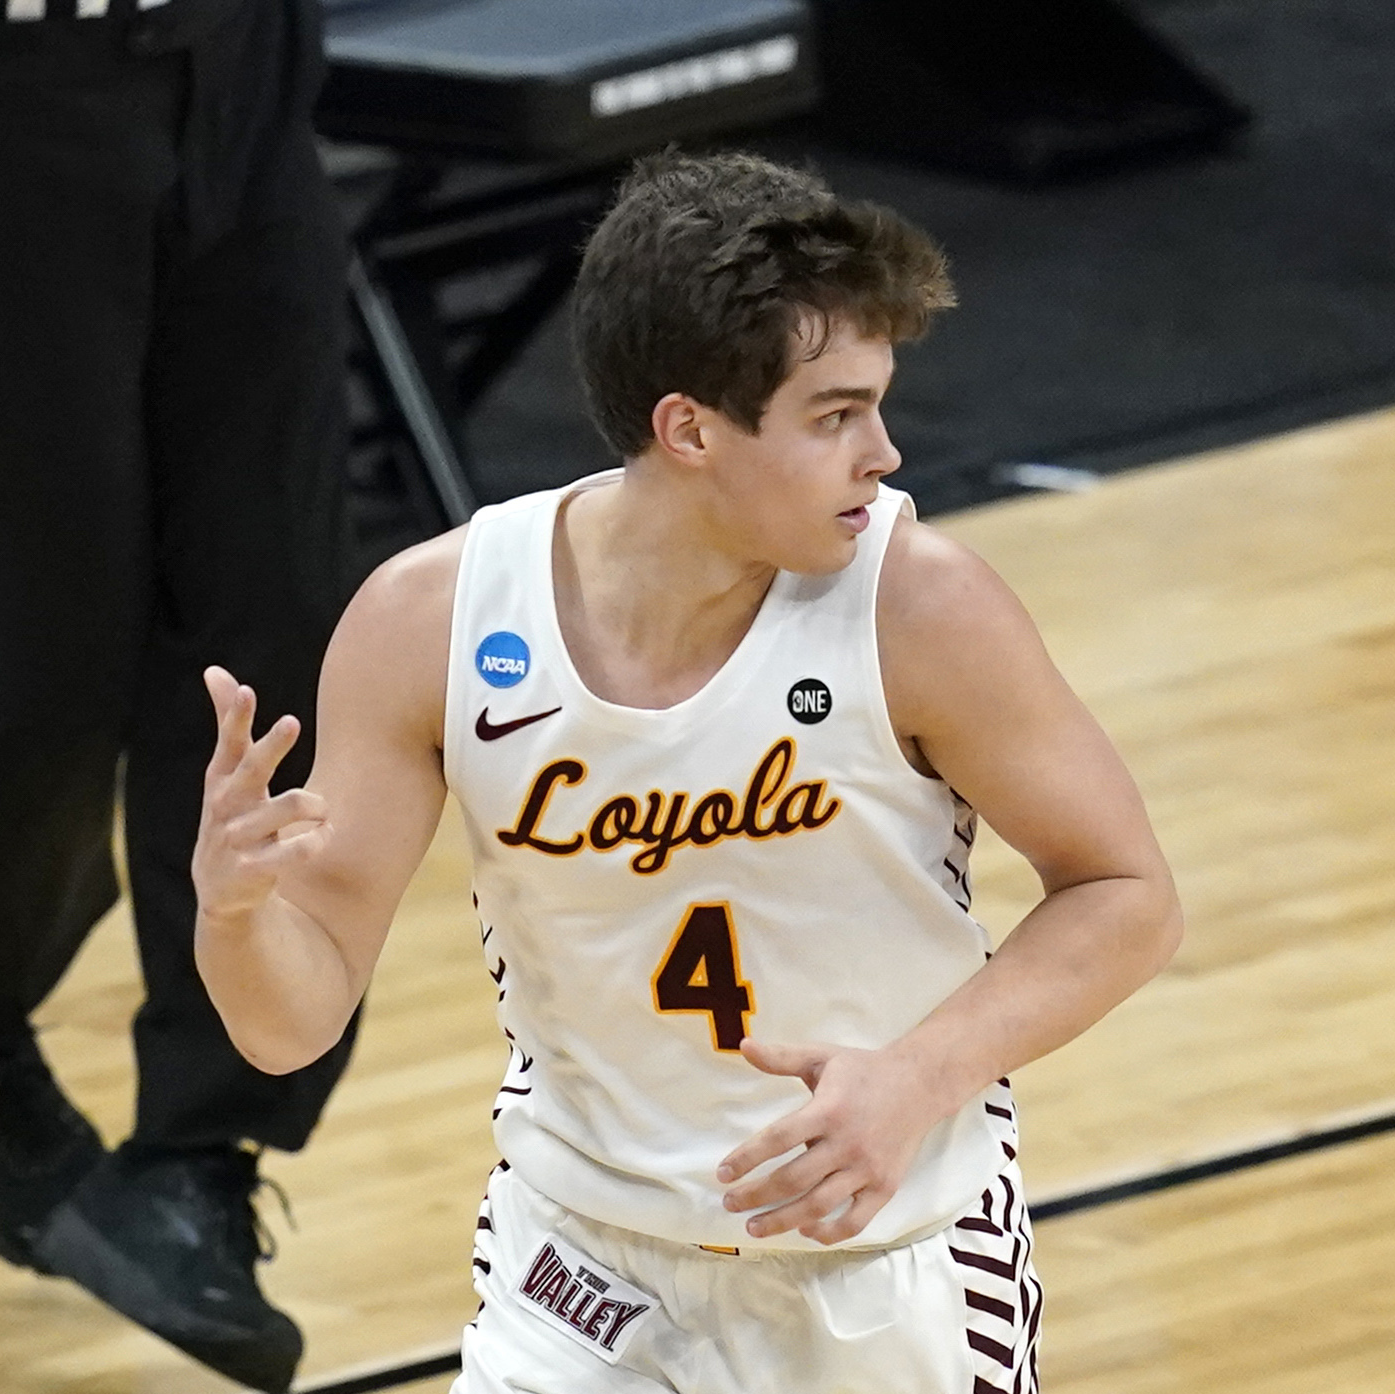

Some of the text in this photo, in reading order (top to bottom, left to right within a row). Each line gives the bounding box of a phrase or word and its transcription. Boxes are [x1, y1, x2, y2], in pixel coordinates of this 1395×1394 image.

[482, 655, 525, 675] NCAA
[792, 690, 827, 713] ONE
[495, 737, 842, 875] Loyola
[650, 901, 756, 1053] 4
[519, 1241, 650, 1352] VALLEY
